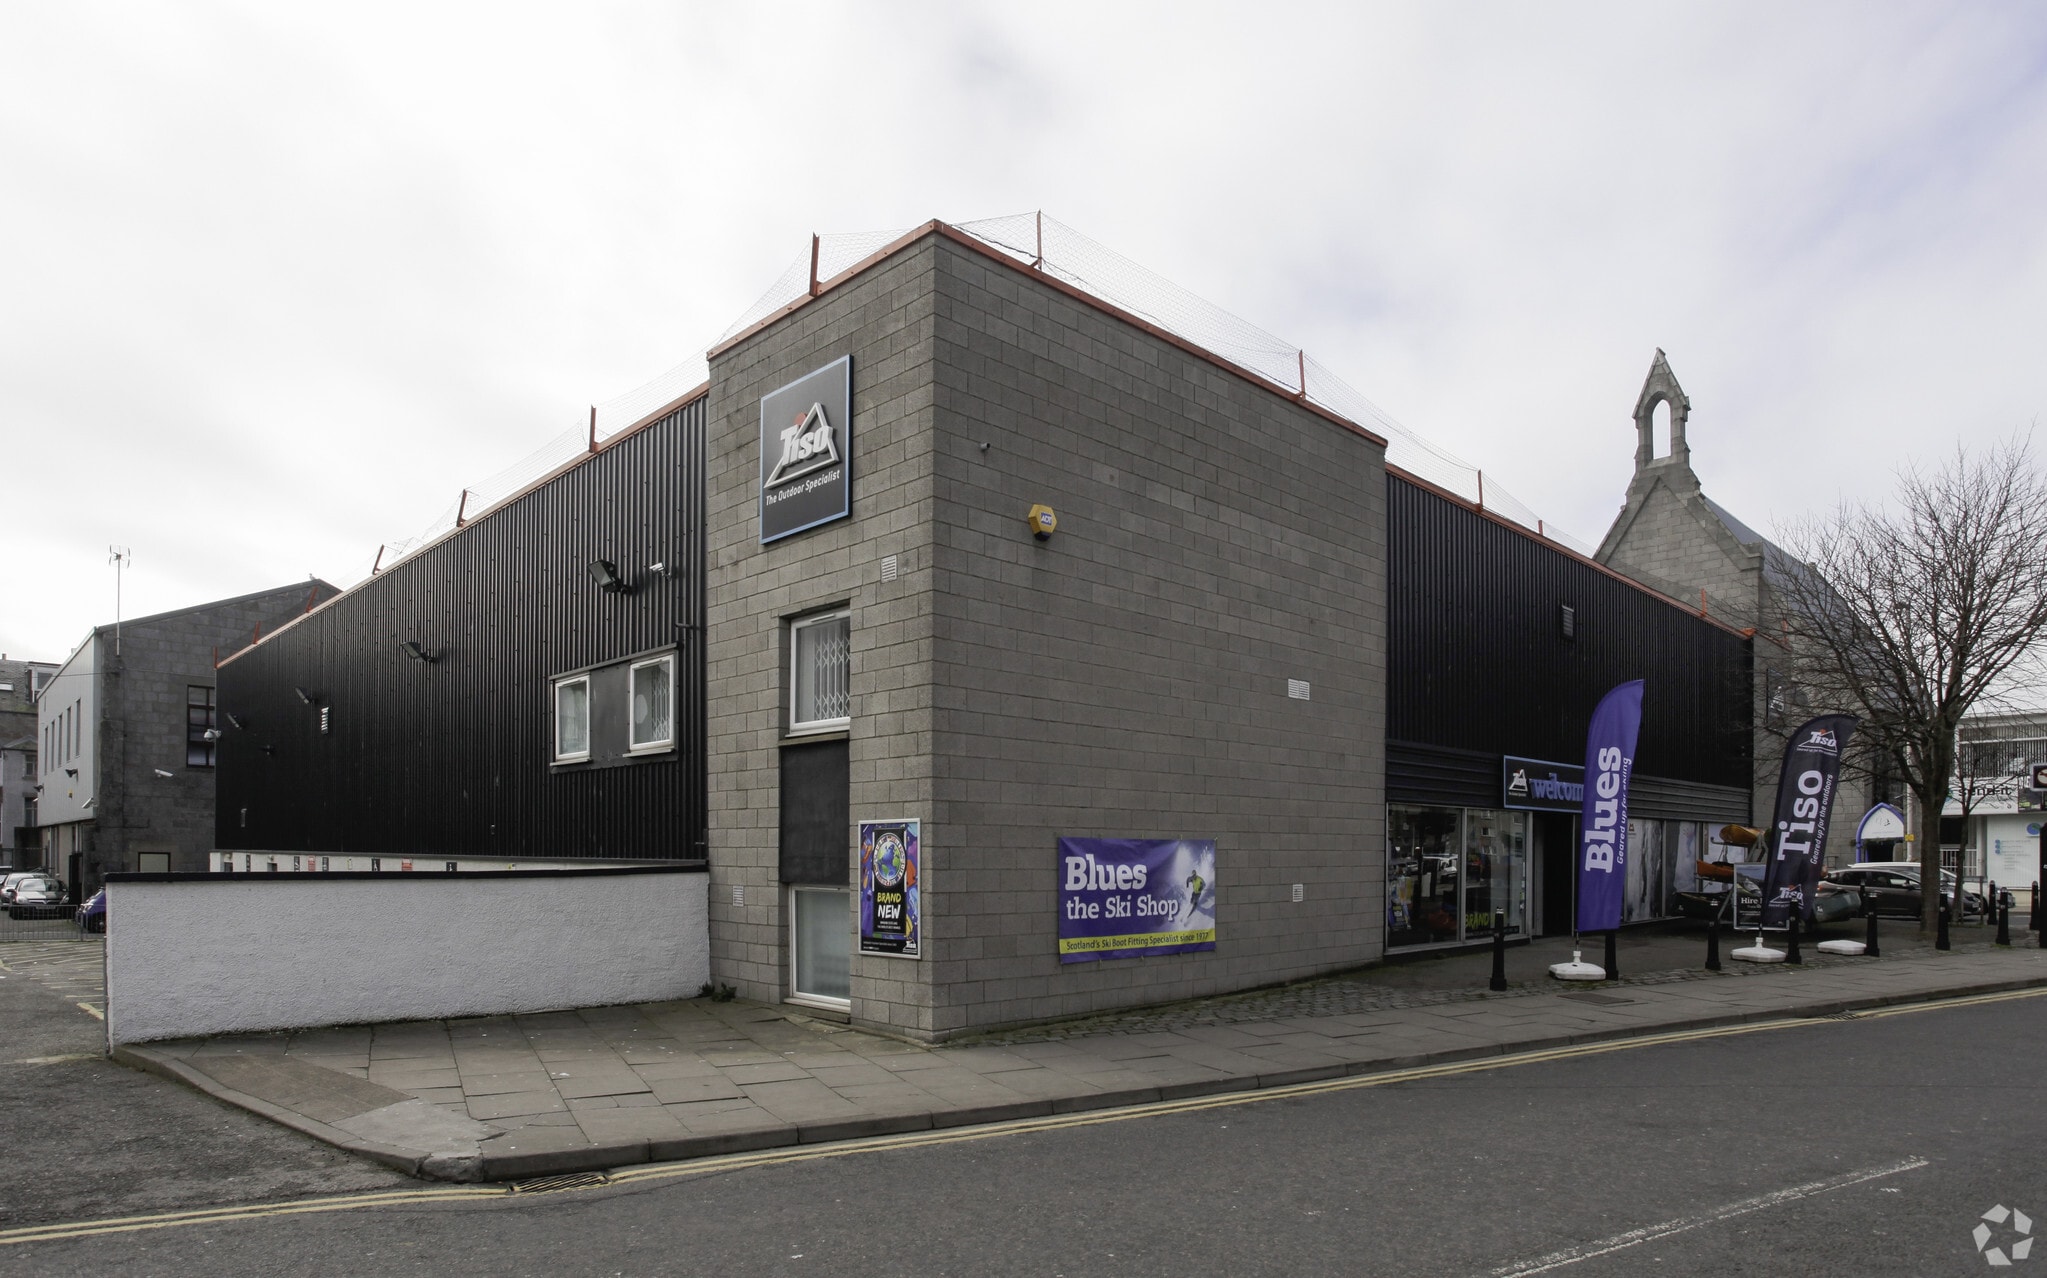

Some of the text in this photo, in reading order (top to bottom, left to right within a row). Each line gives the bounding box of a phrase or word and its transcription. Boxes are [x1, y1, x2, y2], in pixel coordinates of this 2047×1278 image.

[780, 413, 833, 468] Tiso
[766, 470, 840, 505] The Outdoor Specialist
[1810, 728, 1837, 747] Tiso
[1529, 772, 1584, 801] welcom
[1623, 757, 1632, 790] skiing
[1822, 773, 1834, 805] outdoors
[1584, 746, 1622, 874] Blues
[1621, 811, 1627, 824] up
[1777, 770, 1823, 861] Tiso
[1817, 817, 1826, 831] for
[1817, 829, 1825, 839] up
[1617, 825, 1626, 865] Geared
[1809, 838, 1822, 865] Geared
[1065, 854, 1147, 891] Blues
[877, 892, 901, 904] BRAND
[877, 904, 901, 919] NEW
[1066, 895, 1178, 921] the Ski Shop
[1740, 897, 1759, 905] Hire
[1066, 931, 1209, 951] Scotland's Ski Boot Fitting Specialist since 1977
